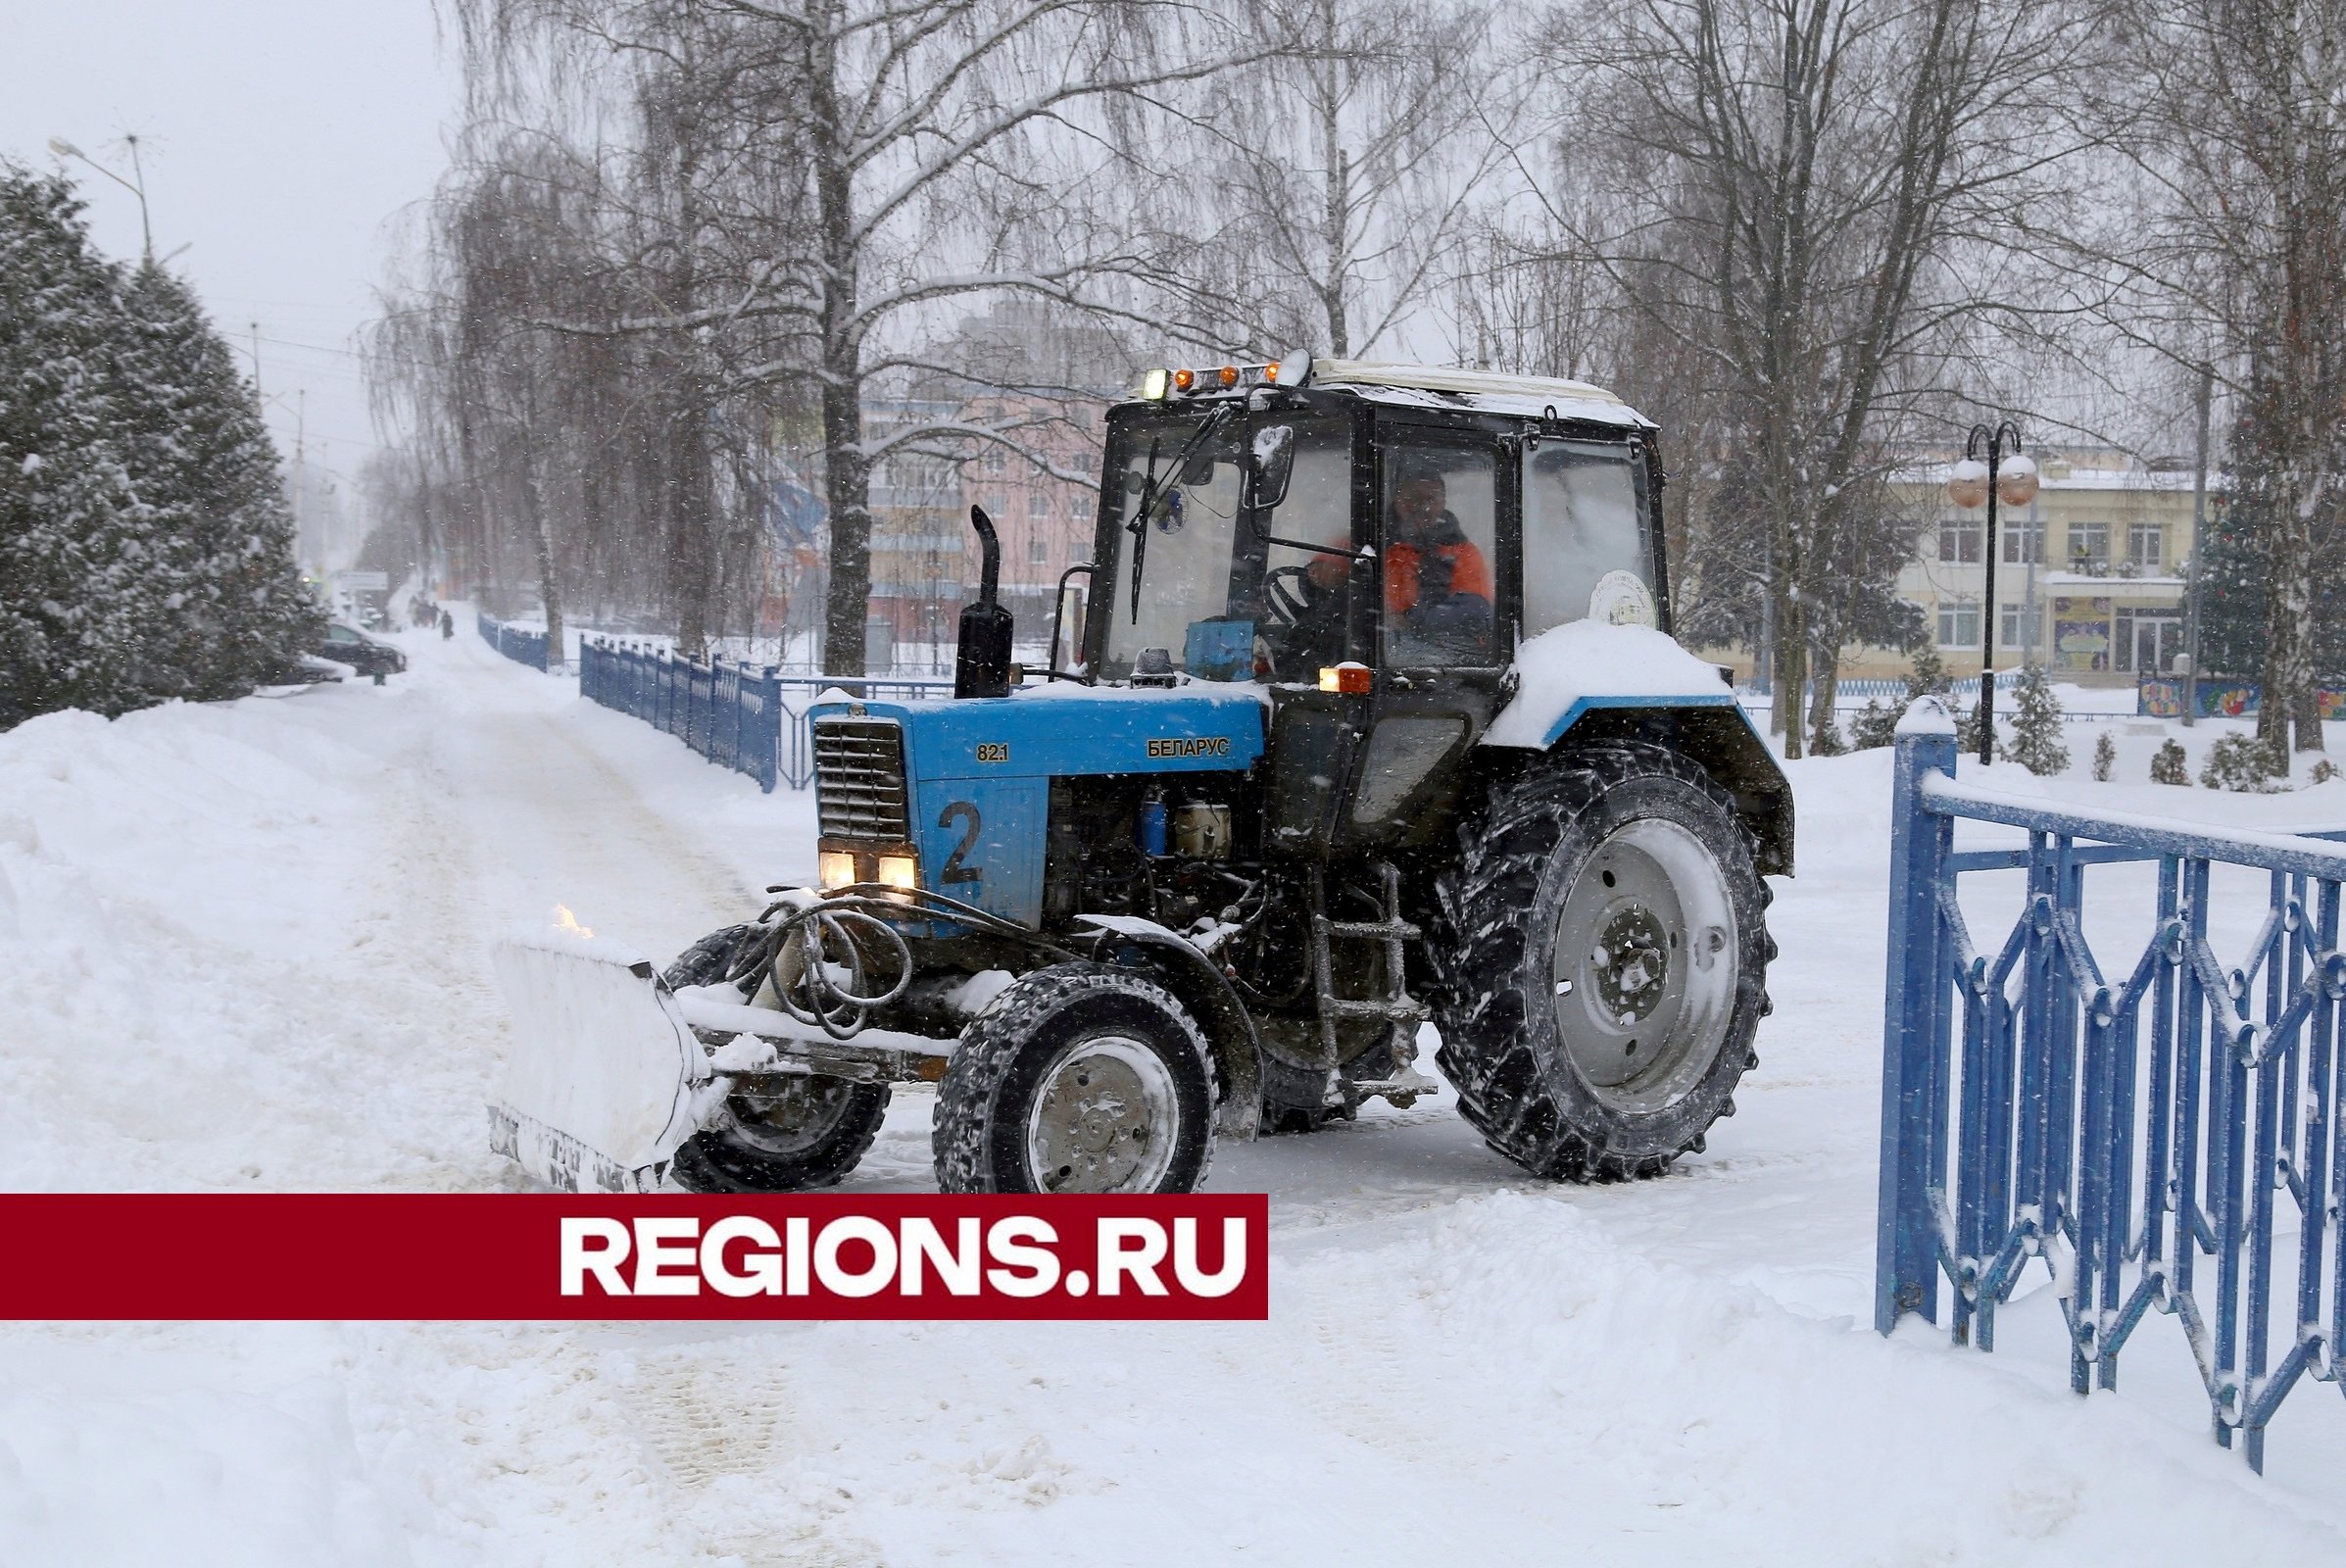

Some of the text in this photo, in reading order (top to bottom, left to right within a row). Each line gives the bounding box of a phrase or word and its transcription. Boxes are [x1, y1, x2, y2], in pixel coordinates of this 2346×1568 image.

[976, 743, 1008, 762] 82.1
[1148, 737, 1230, 759] БЕЛАРУС
[938, 801, 983, 885] 2
